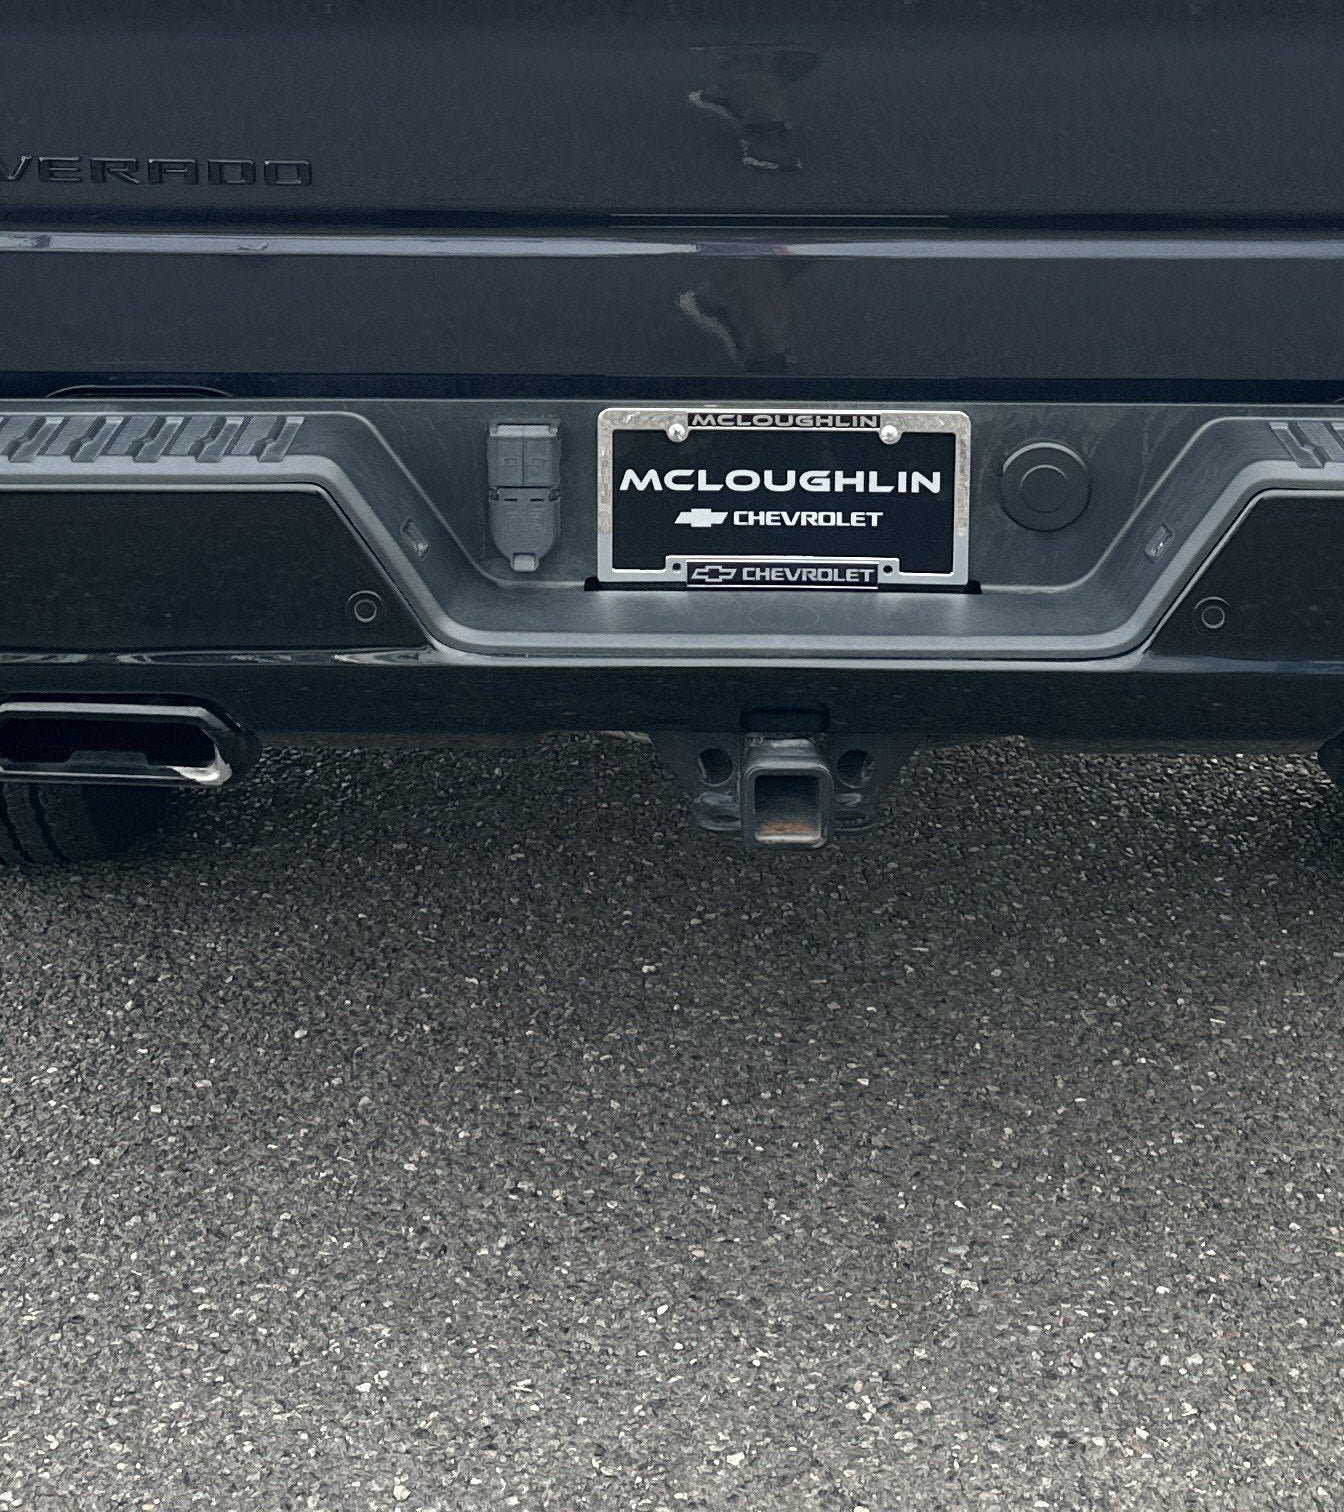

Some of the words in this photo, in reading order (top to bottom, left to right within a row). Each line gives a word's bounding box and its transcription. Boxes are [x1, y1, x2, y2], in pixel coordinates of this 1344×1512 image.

[691, 413, 879, 429] MCLOUGHLIN
[619, 468, 942, 494] MCLOUGHLIN
[733, 509, 884, 527] CHEVROLET
[742, 566, 876, 584] CHEVROLET
